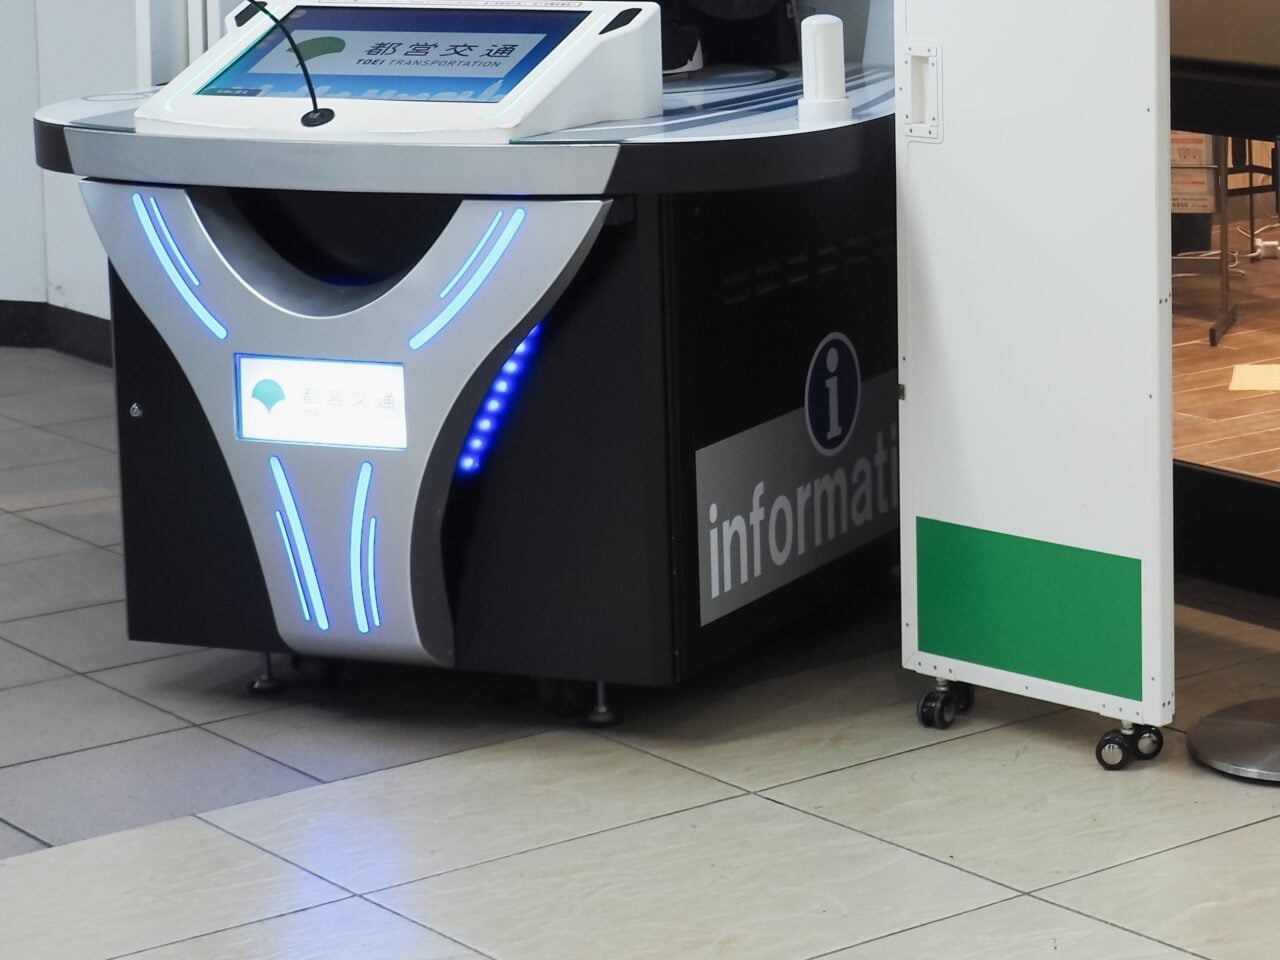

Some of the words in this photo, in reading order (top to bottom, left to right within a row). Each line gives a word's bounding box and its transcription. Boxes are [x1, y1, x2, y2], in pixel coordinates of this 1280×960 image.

[364, 41, 520, 58] 都営交通
[355, 58, 386, 66] TOEI
[388, 59, 502, 68] TRANSPORTATION
[708, 423, 897, 600] informati
